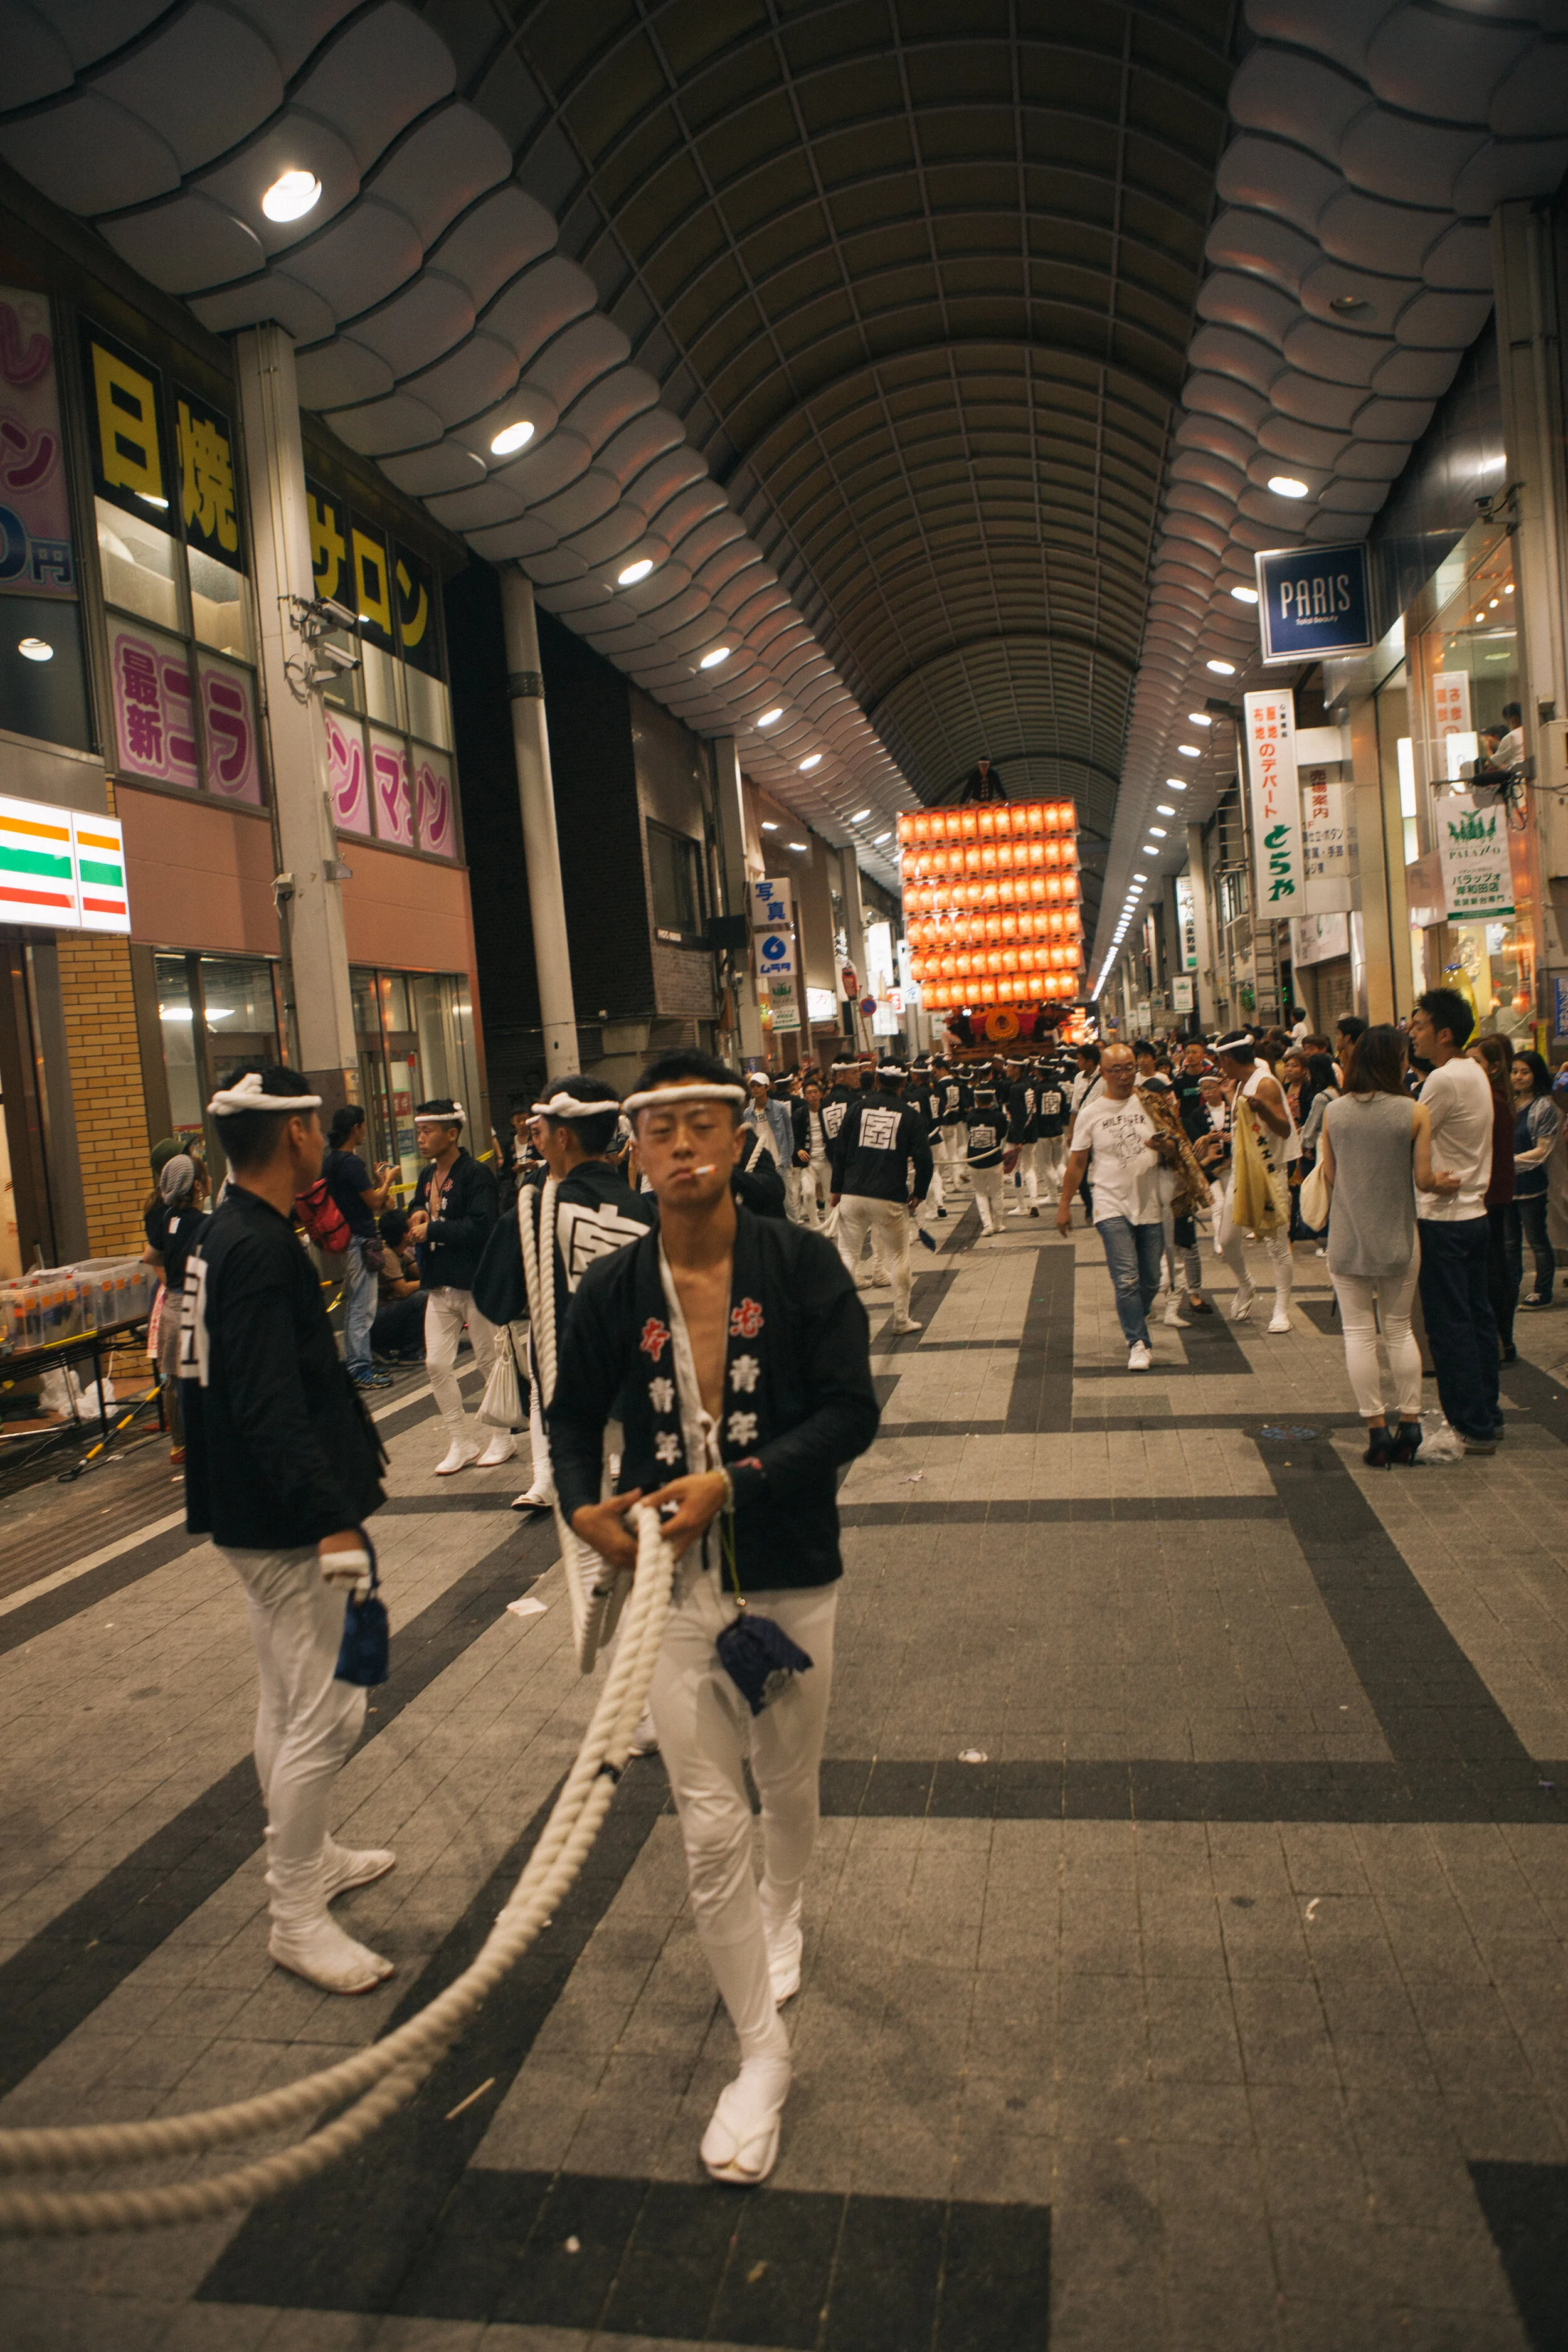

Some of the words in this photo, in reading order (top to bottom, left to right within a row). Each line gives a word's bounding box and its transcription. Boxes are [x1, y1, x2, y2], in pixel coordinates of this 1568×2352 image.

[1280, 574, 1350, 619] PARIS
[1259, 743, 1278, 818] のデパート
[1264, 824, 1296, 901] とらや
[755, 882, 785, 921] 写真
[760, 962, 791, 974] ムラタ
